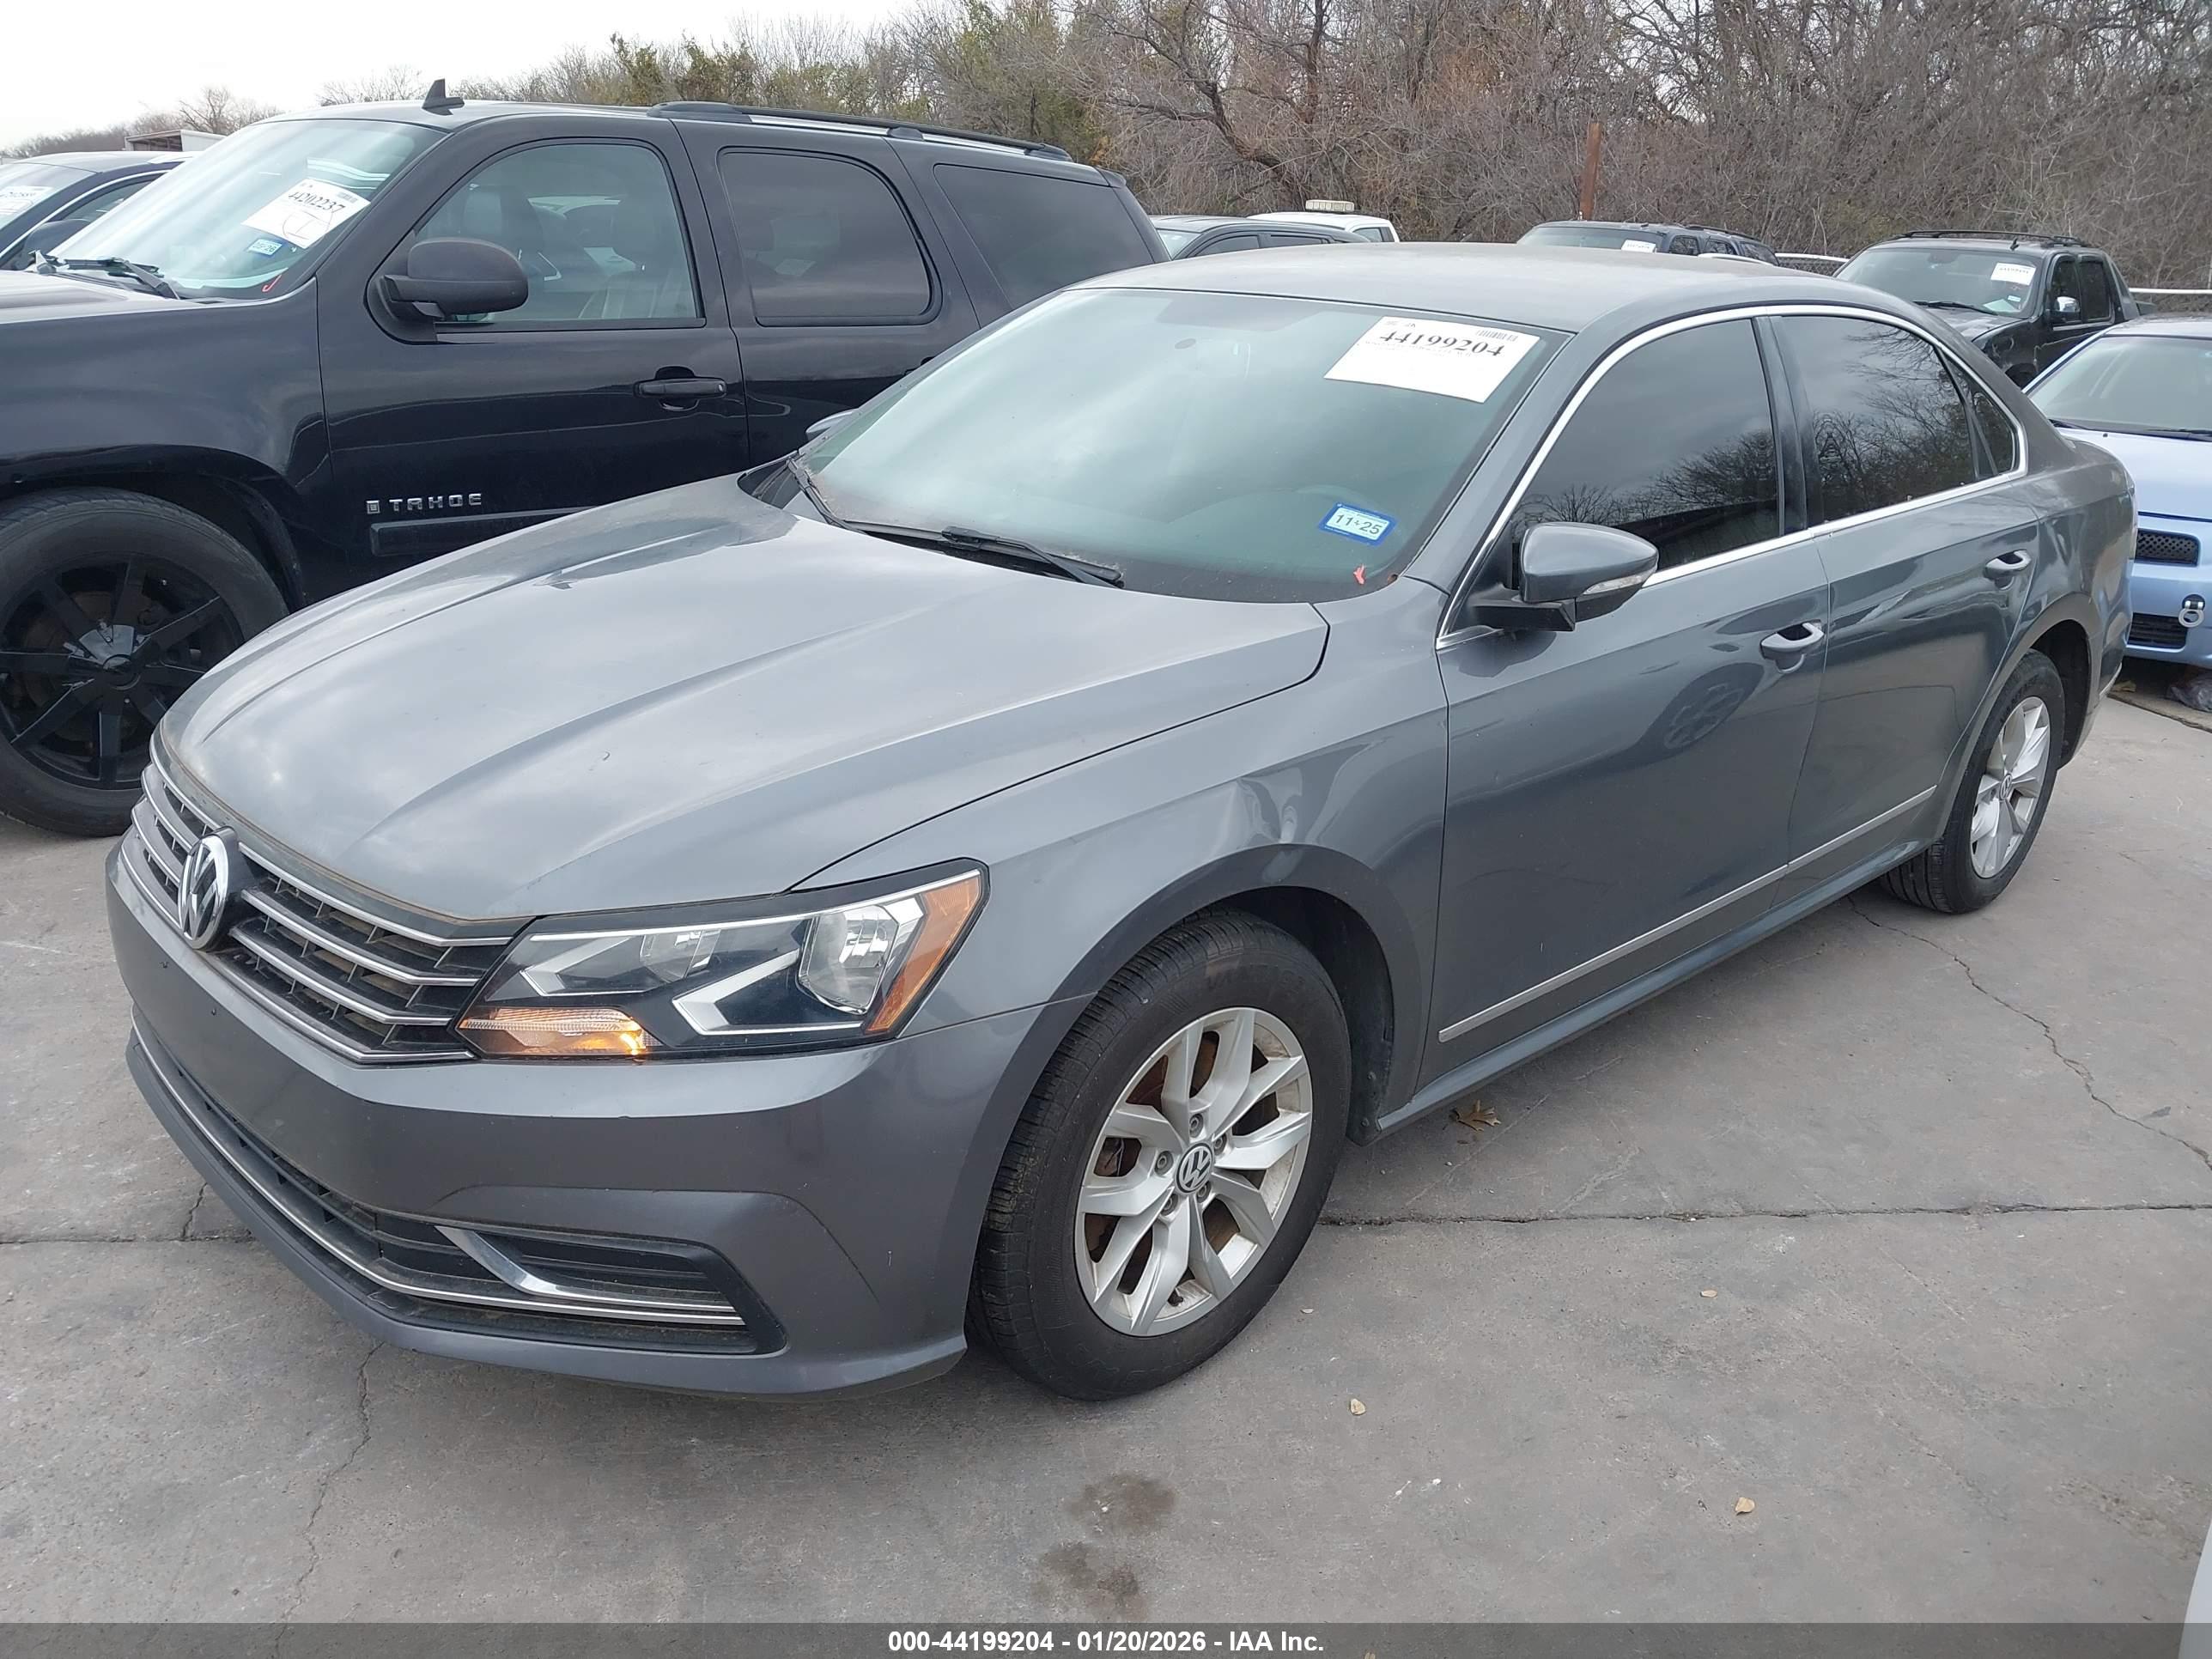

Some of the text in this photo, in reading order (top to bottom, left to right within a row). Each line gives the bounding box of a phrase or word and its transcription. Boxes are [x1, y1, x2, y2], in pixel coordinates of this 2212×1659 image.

[289, 191, 346, 214] 44202237
[1379, 331, 1505, 357] 44199204
[389, 493, 482, 512] TAHOE
